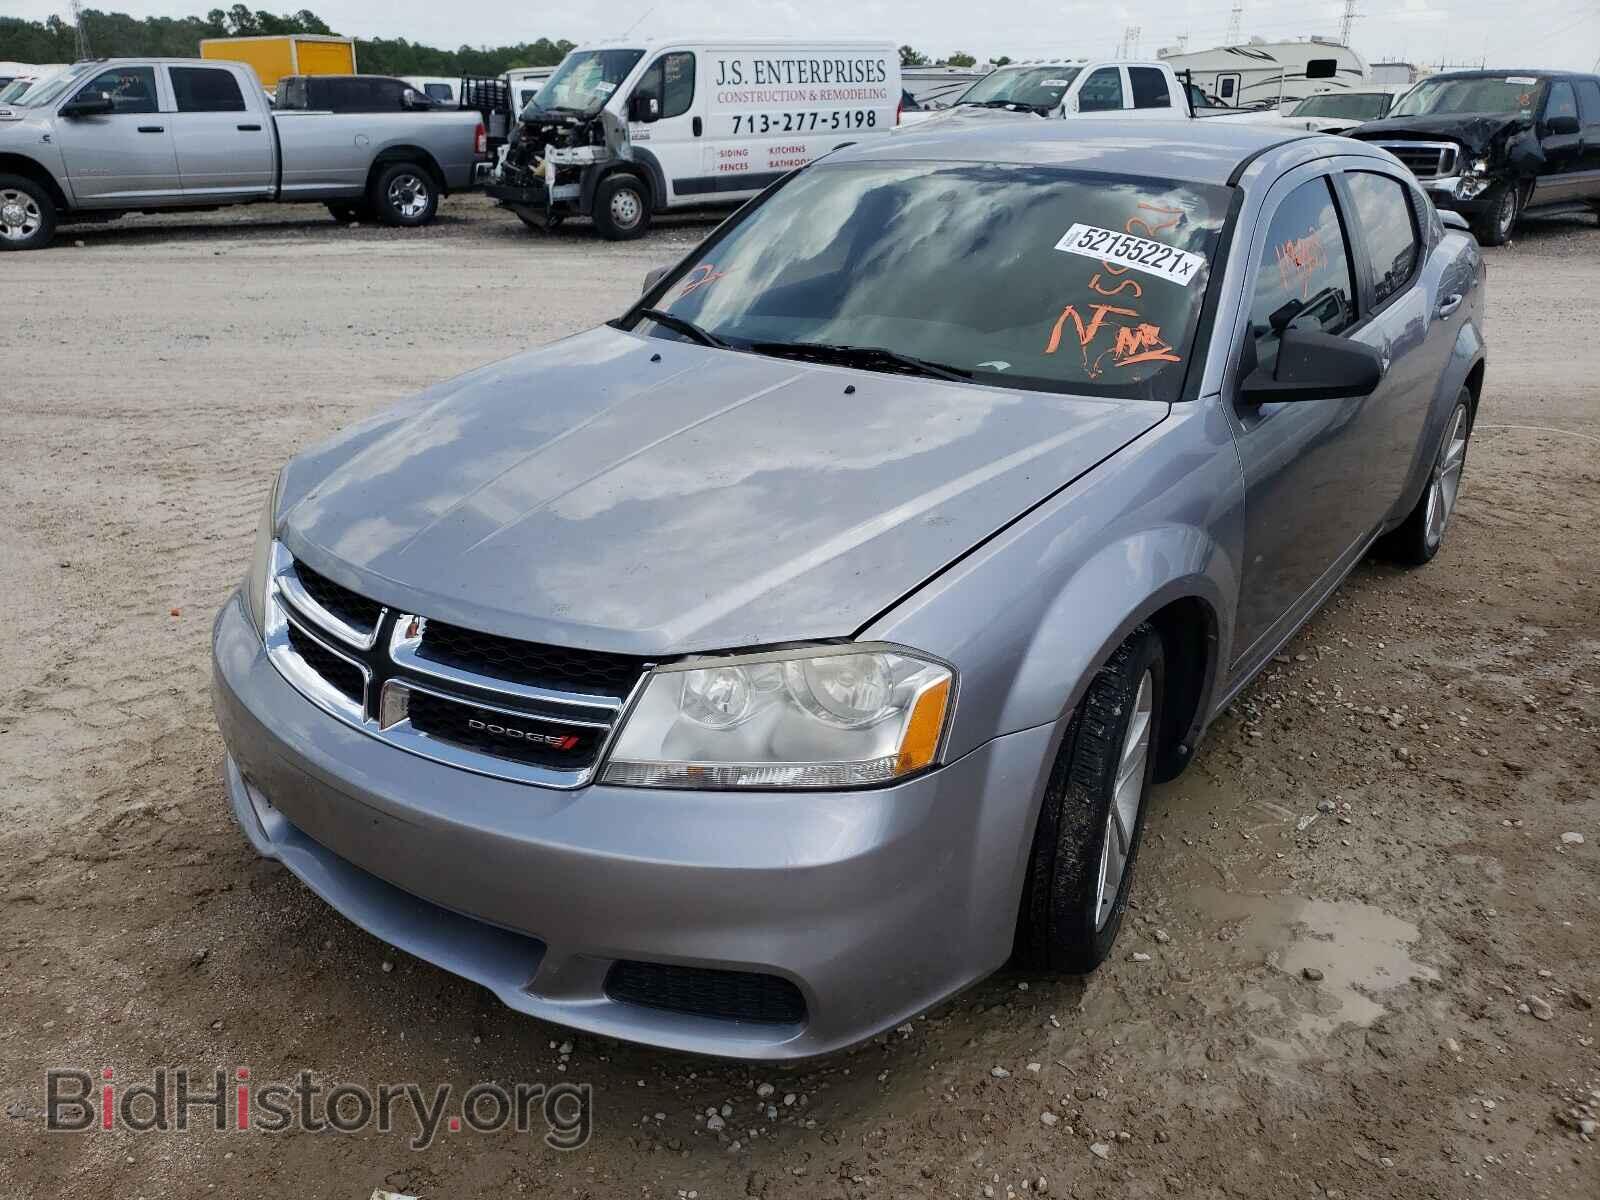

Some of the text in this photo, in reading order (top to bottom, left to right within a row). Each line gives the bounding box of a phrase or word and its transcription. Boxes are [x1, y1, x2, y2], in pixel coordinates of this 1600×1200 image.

[716, 60, 748, 85] J.S.
[754, 58, 886, 84] ENTERPRISES
[718, 88, 887, 104] CONSTRUCTION & REMODELING
[732, 110, 876, 134] 713-277-5198
[468, 719, 563, 746] DODGE
